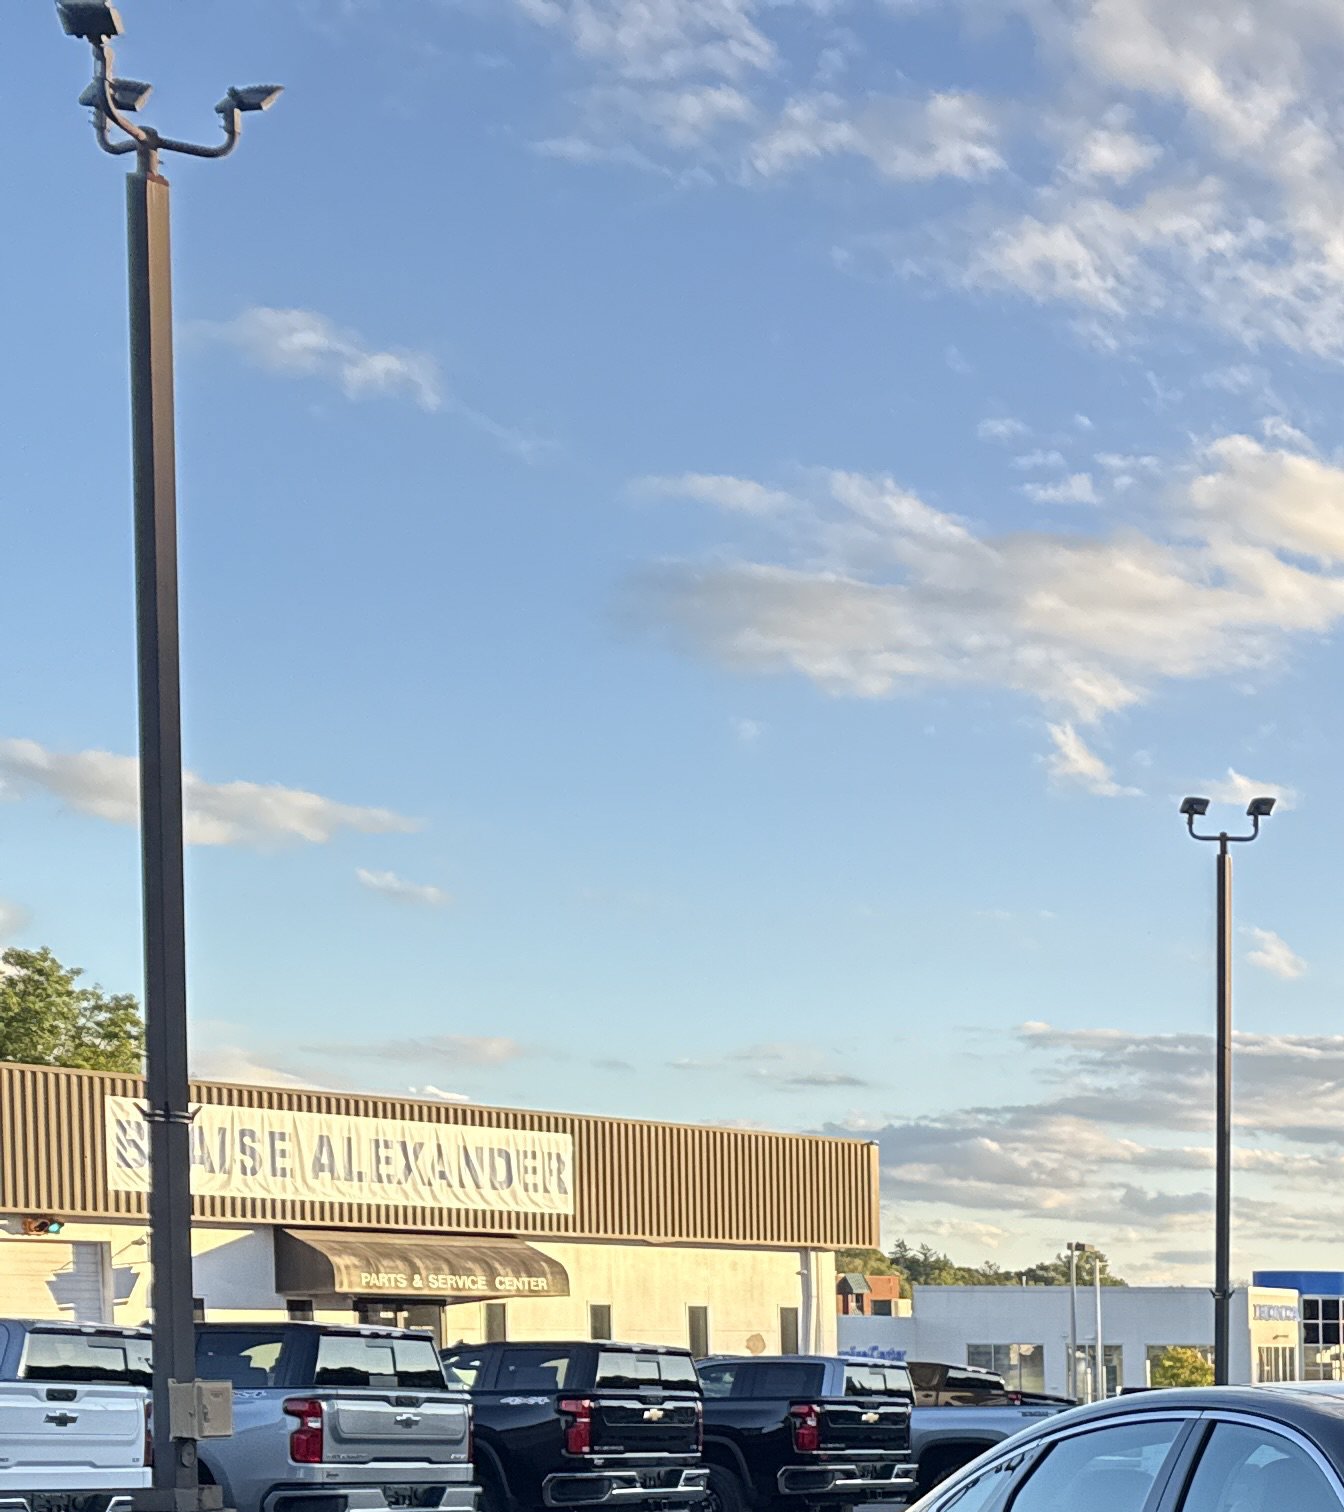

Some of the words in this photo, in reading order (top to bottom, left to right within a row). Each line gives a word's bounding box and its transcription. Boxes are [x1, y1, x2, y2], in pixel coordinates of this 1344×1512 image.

[114, 1117, 293, 1180] BAISE
[311, 1133, 569, 1196] ALEXANDER
[360, 1272, 407, 1288] PARTS
[412, 1273, 423, 1288] &
[428, 1274, 487, 1290] SERVICE
[495, 1275, 548, 1291] CENTER
